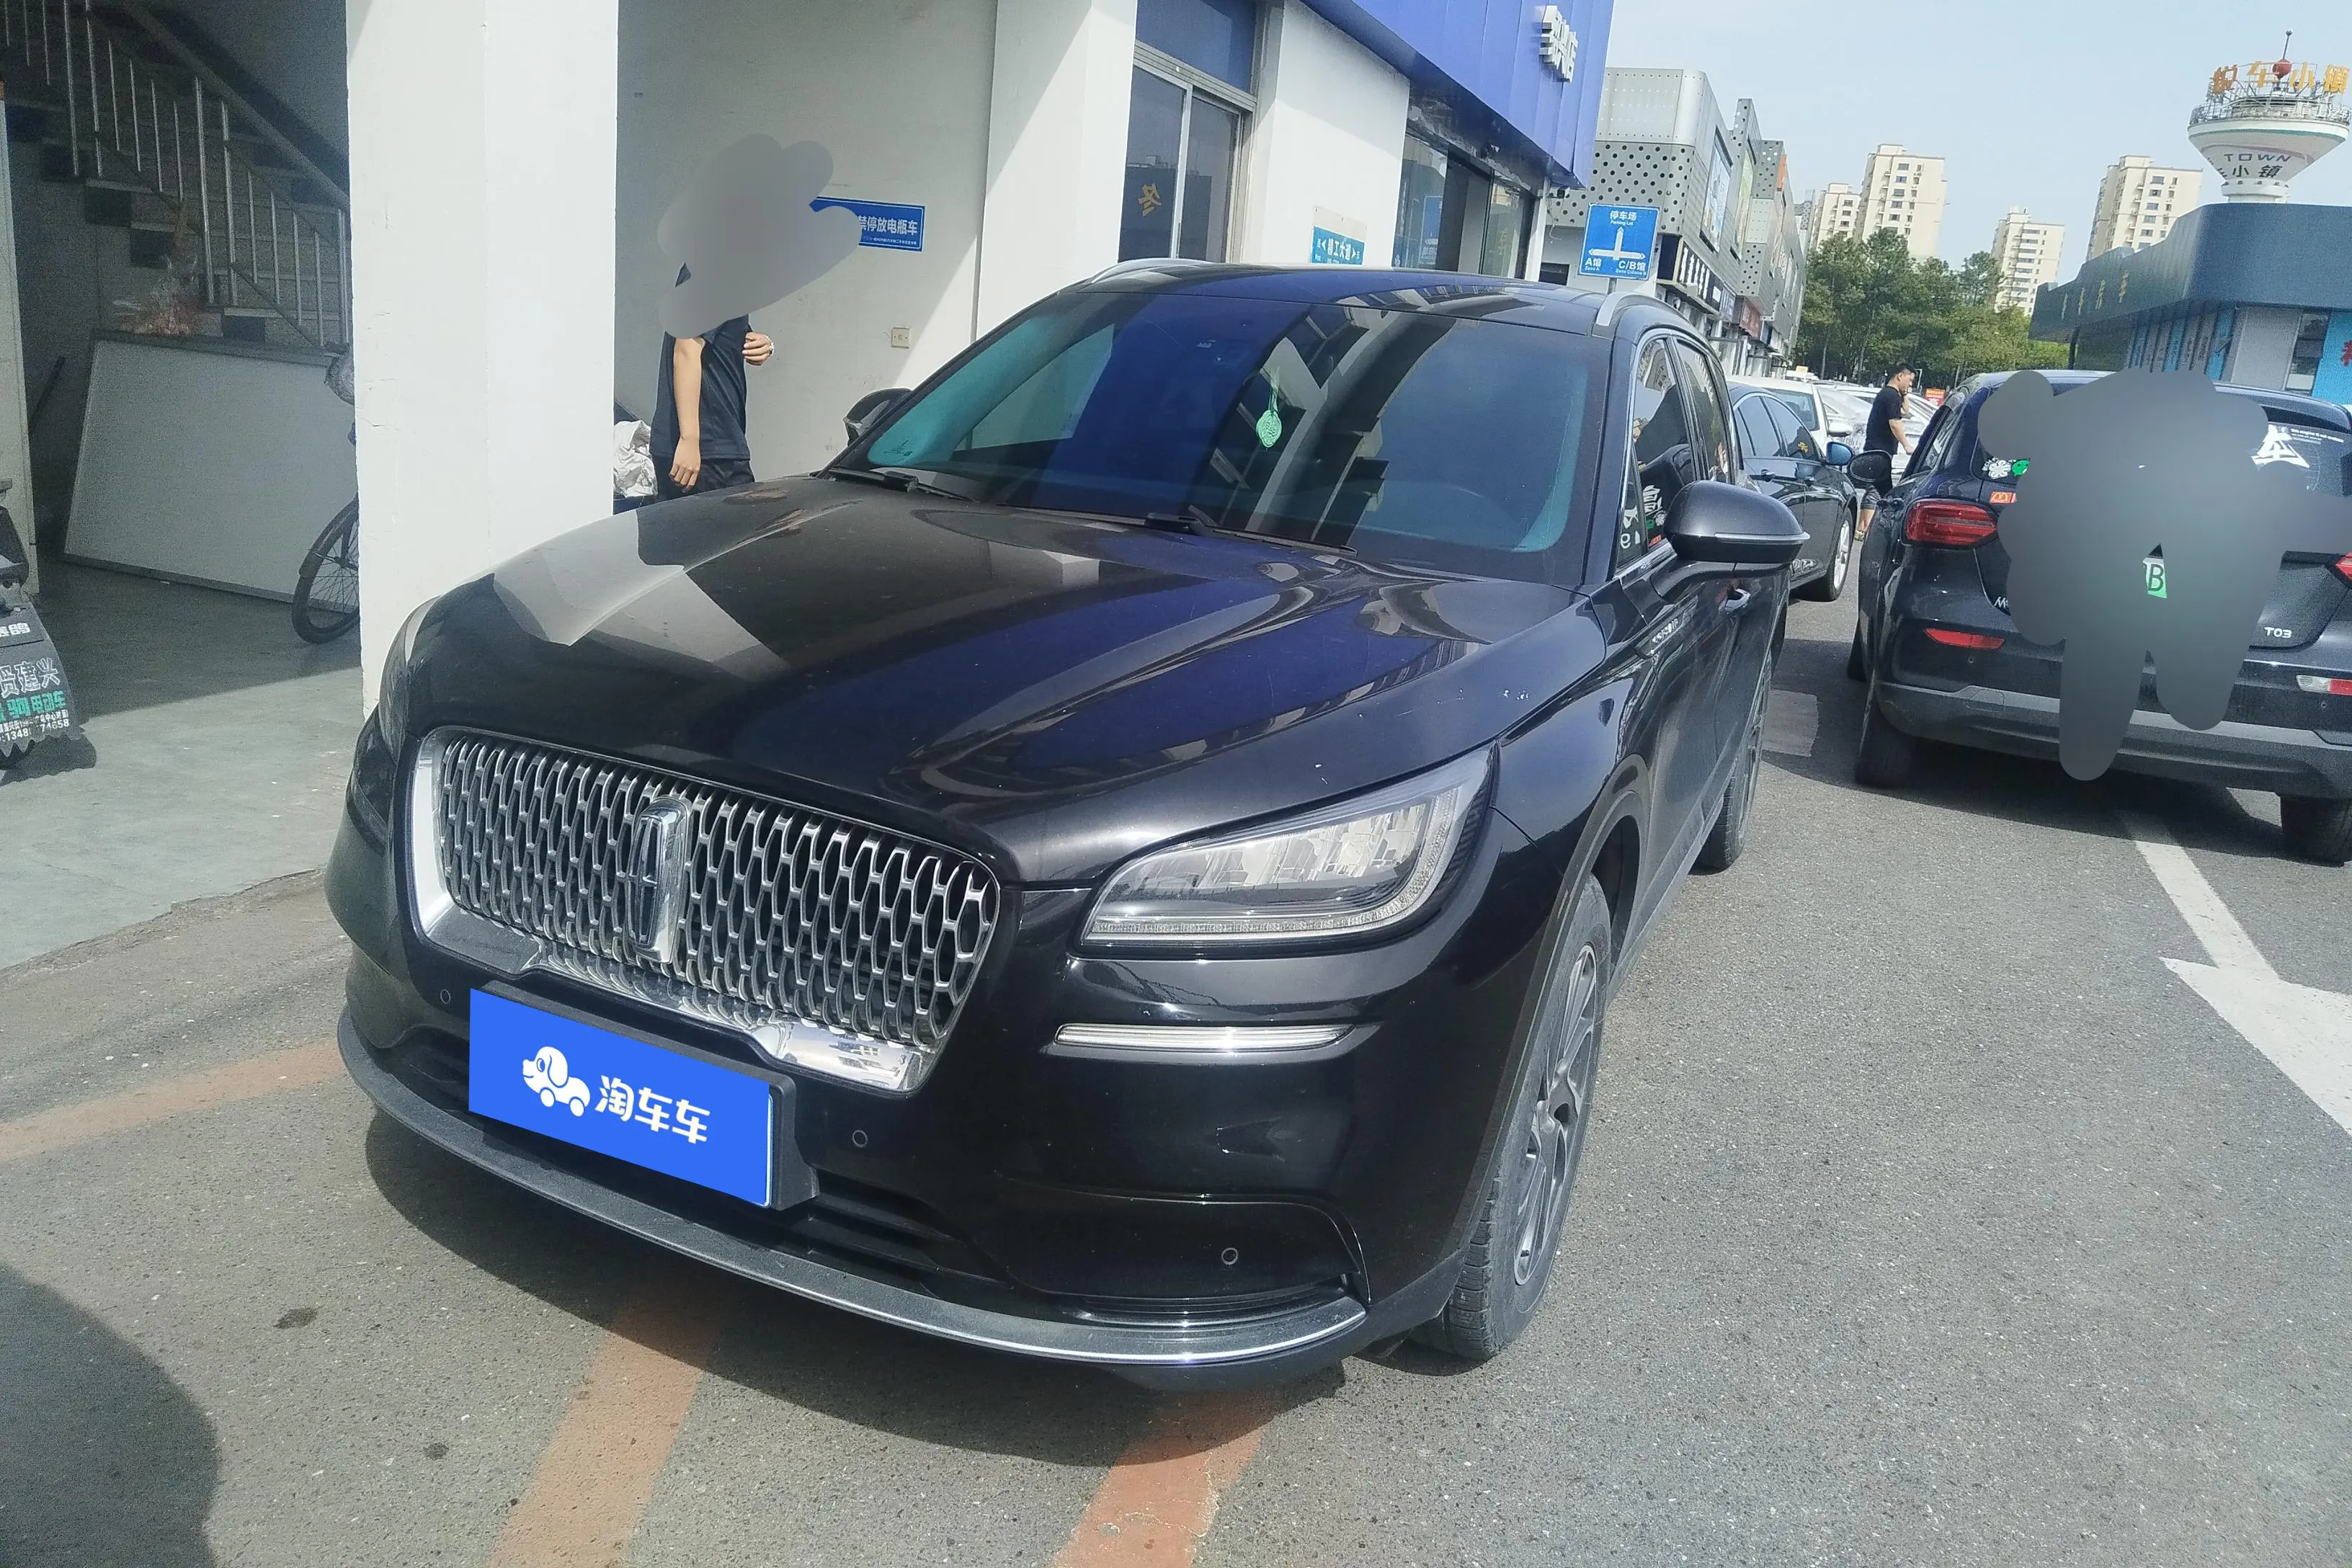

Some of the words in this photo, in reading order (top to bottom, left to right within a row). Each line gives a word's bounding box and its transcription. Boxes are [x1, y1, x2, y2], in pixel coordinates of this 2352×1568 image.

[2224, 153, 2291, 162] TOWN
[2232, 164, 2283, 178] 小镇
[1610, 210, 1637, 221] 停车场
[1618, 260, 1647, 272] C/B馆
